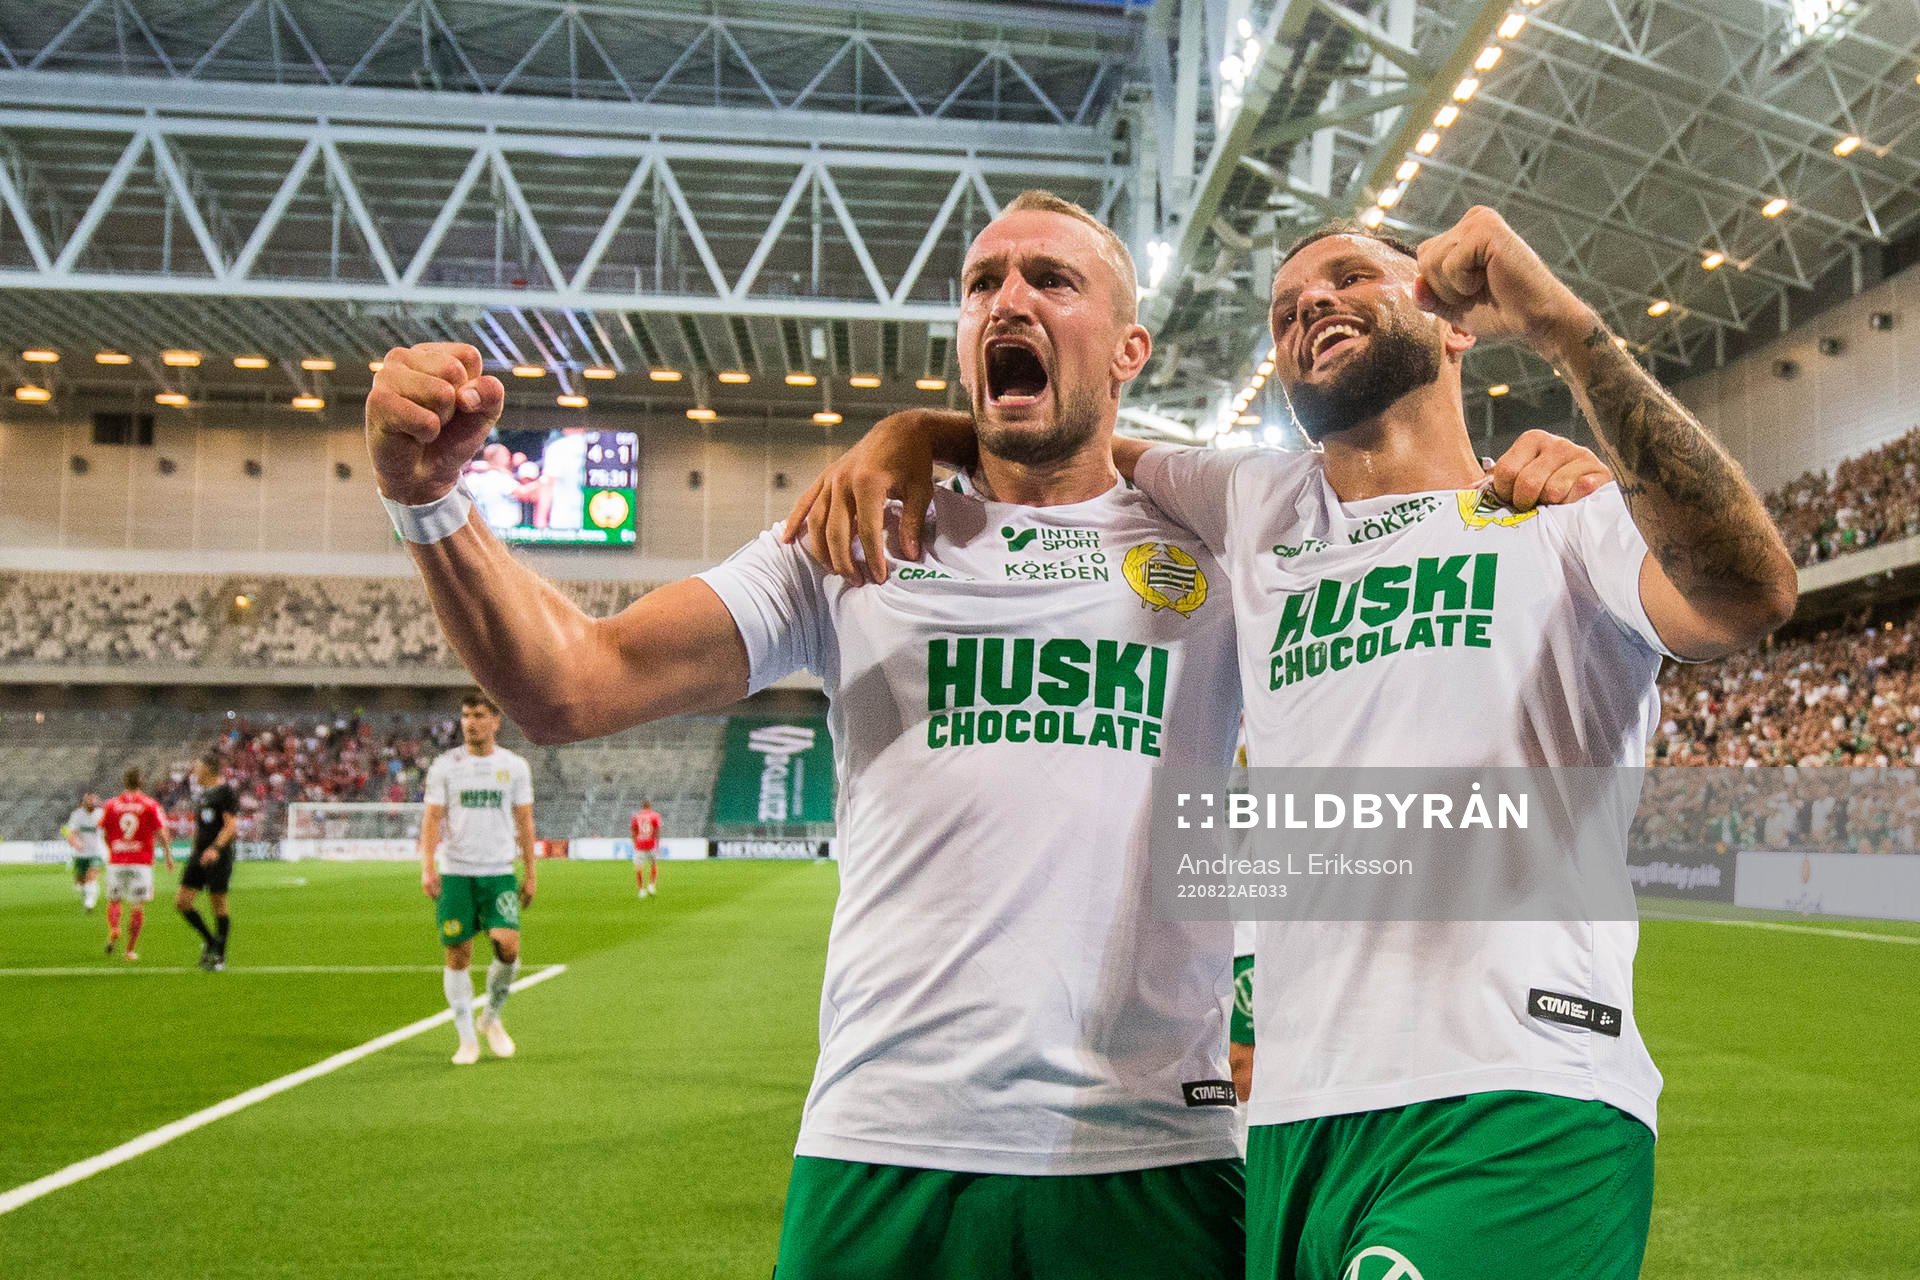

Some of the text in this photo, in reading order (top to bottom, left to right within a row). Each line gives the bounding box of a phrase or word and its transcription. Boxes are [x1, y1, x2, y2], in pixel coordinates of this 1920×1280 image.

[1041, 527, 1099, 539] INTER
[1042, 539, 1100, 551] SPORT
[1269, 552, 1499, 655] HUSKI
[928, 637, 1169, 705] HUSKI
[1269, 614, 1493, 692] CHOCOLATE
[927, 705, 1163, 757] CHOCOLATE
[119, 812, 139, 840] 9
